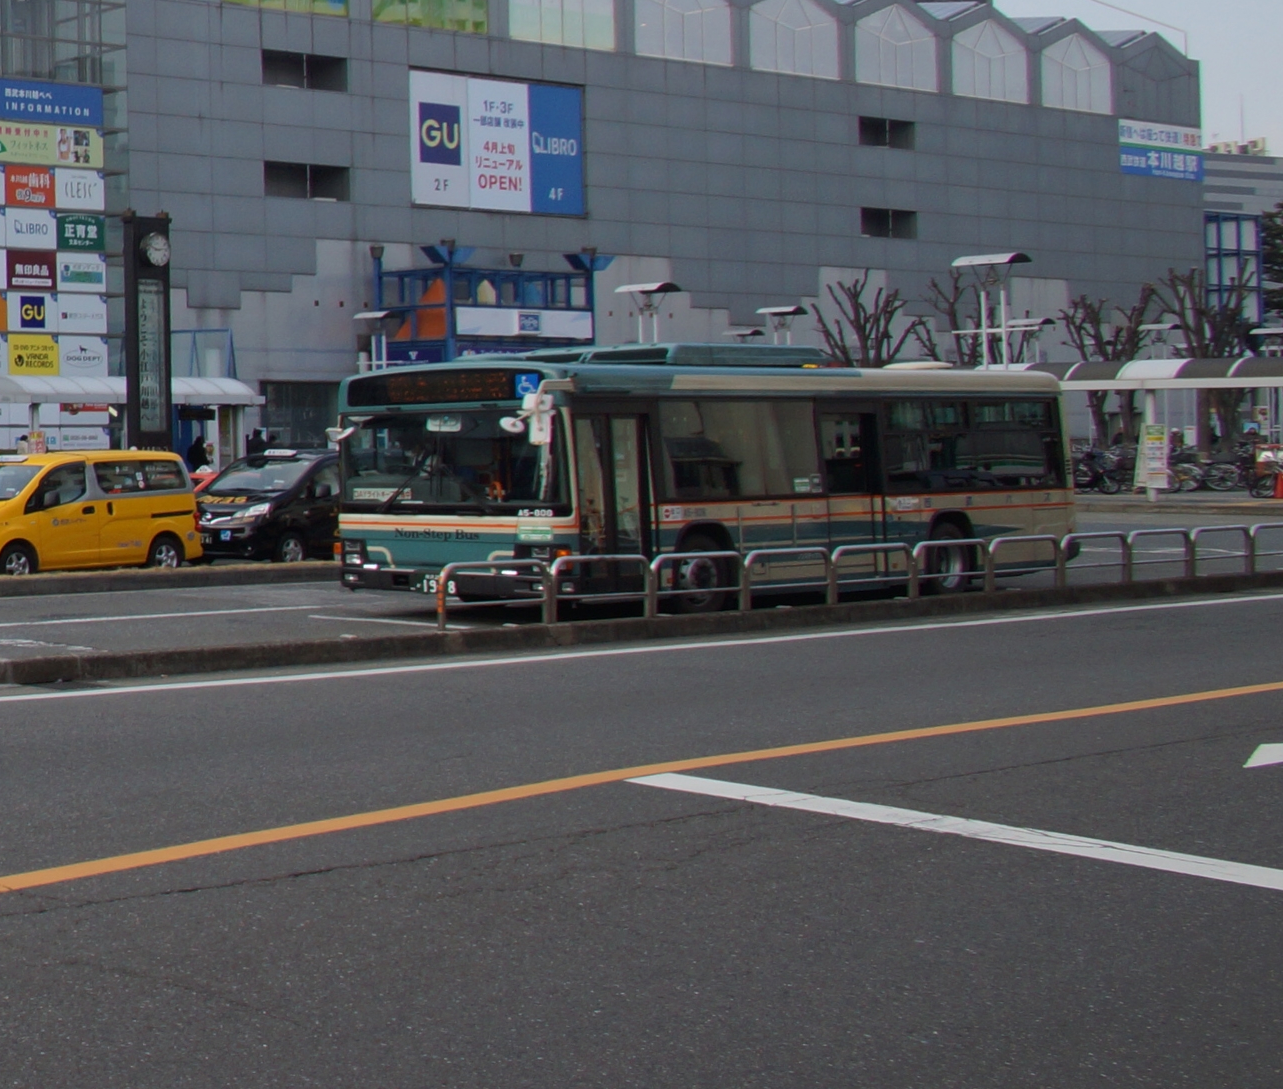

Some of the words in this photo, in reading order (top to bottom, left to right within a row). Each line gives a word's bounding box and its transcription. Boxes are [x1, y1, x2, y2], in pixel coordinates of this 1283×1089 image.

[5, 102, 90, 117] INFORMATION
[421, 118, 459, 150] GU
[10, 140, 49, 151] フィットネス
[483, 141, 515, 156] 4月上旬
[539, 137, 577, 156] LIBRO
[475, 156, 523, 171] リニューアル
[1147, 150, 1198, 172] 本川越駅
[477, 174, 523, 192] OPEN!
[548, 187, 564, 201] 4F
[20, 224, 49, 235] LIBRO
[14, 263, 49, 276] 無印良品
[21, 304, 45, 321] GU
[25, 360, 54, 369] RECORDS
[394, 528, 451, 542] Non-Step
[454, 529, 480, 541] Bus
